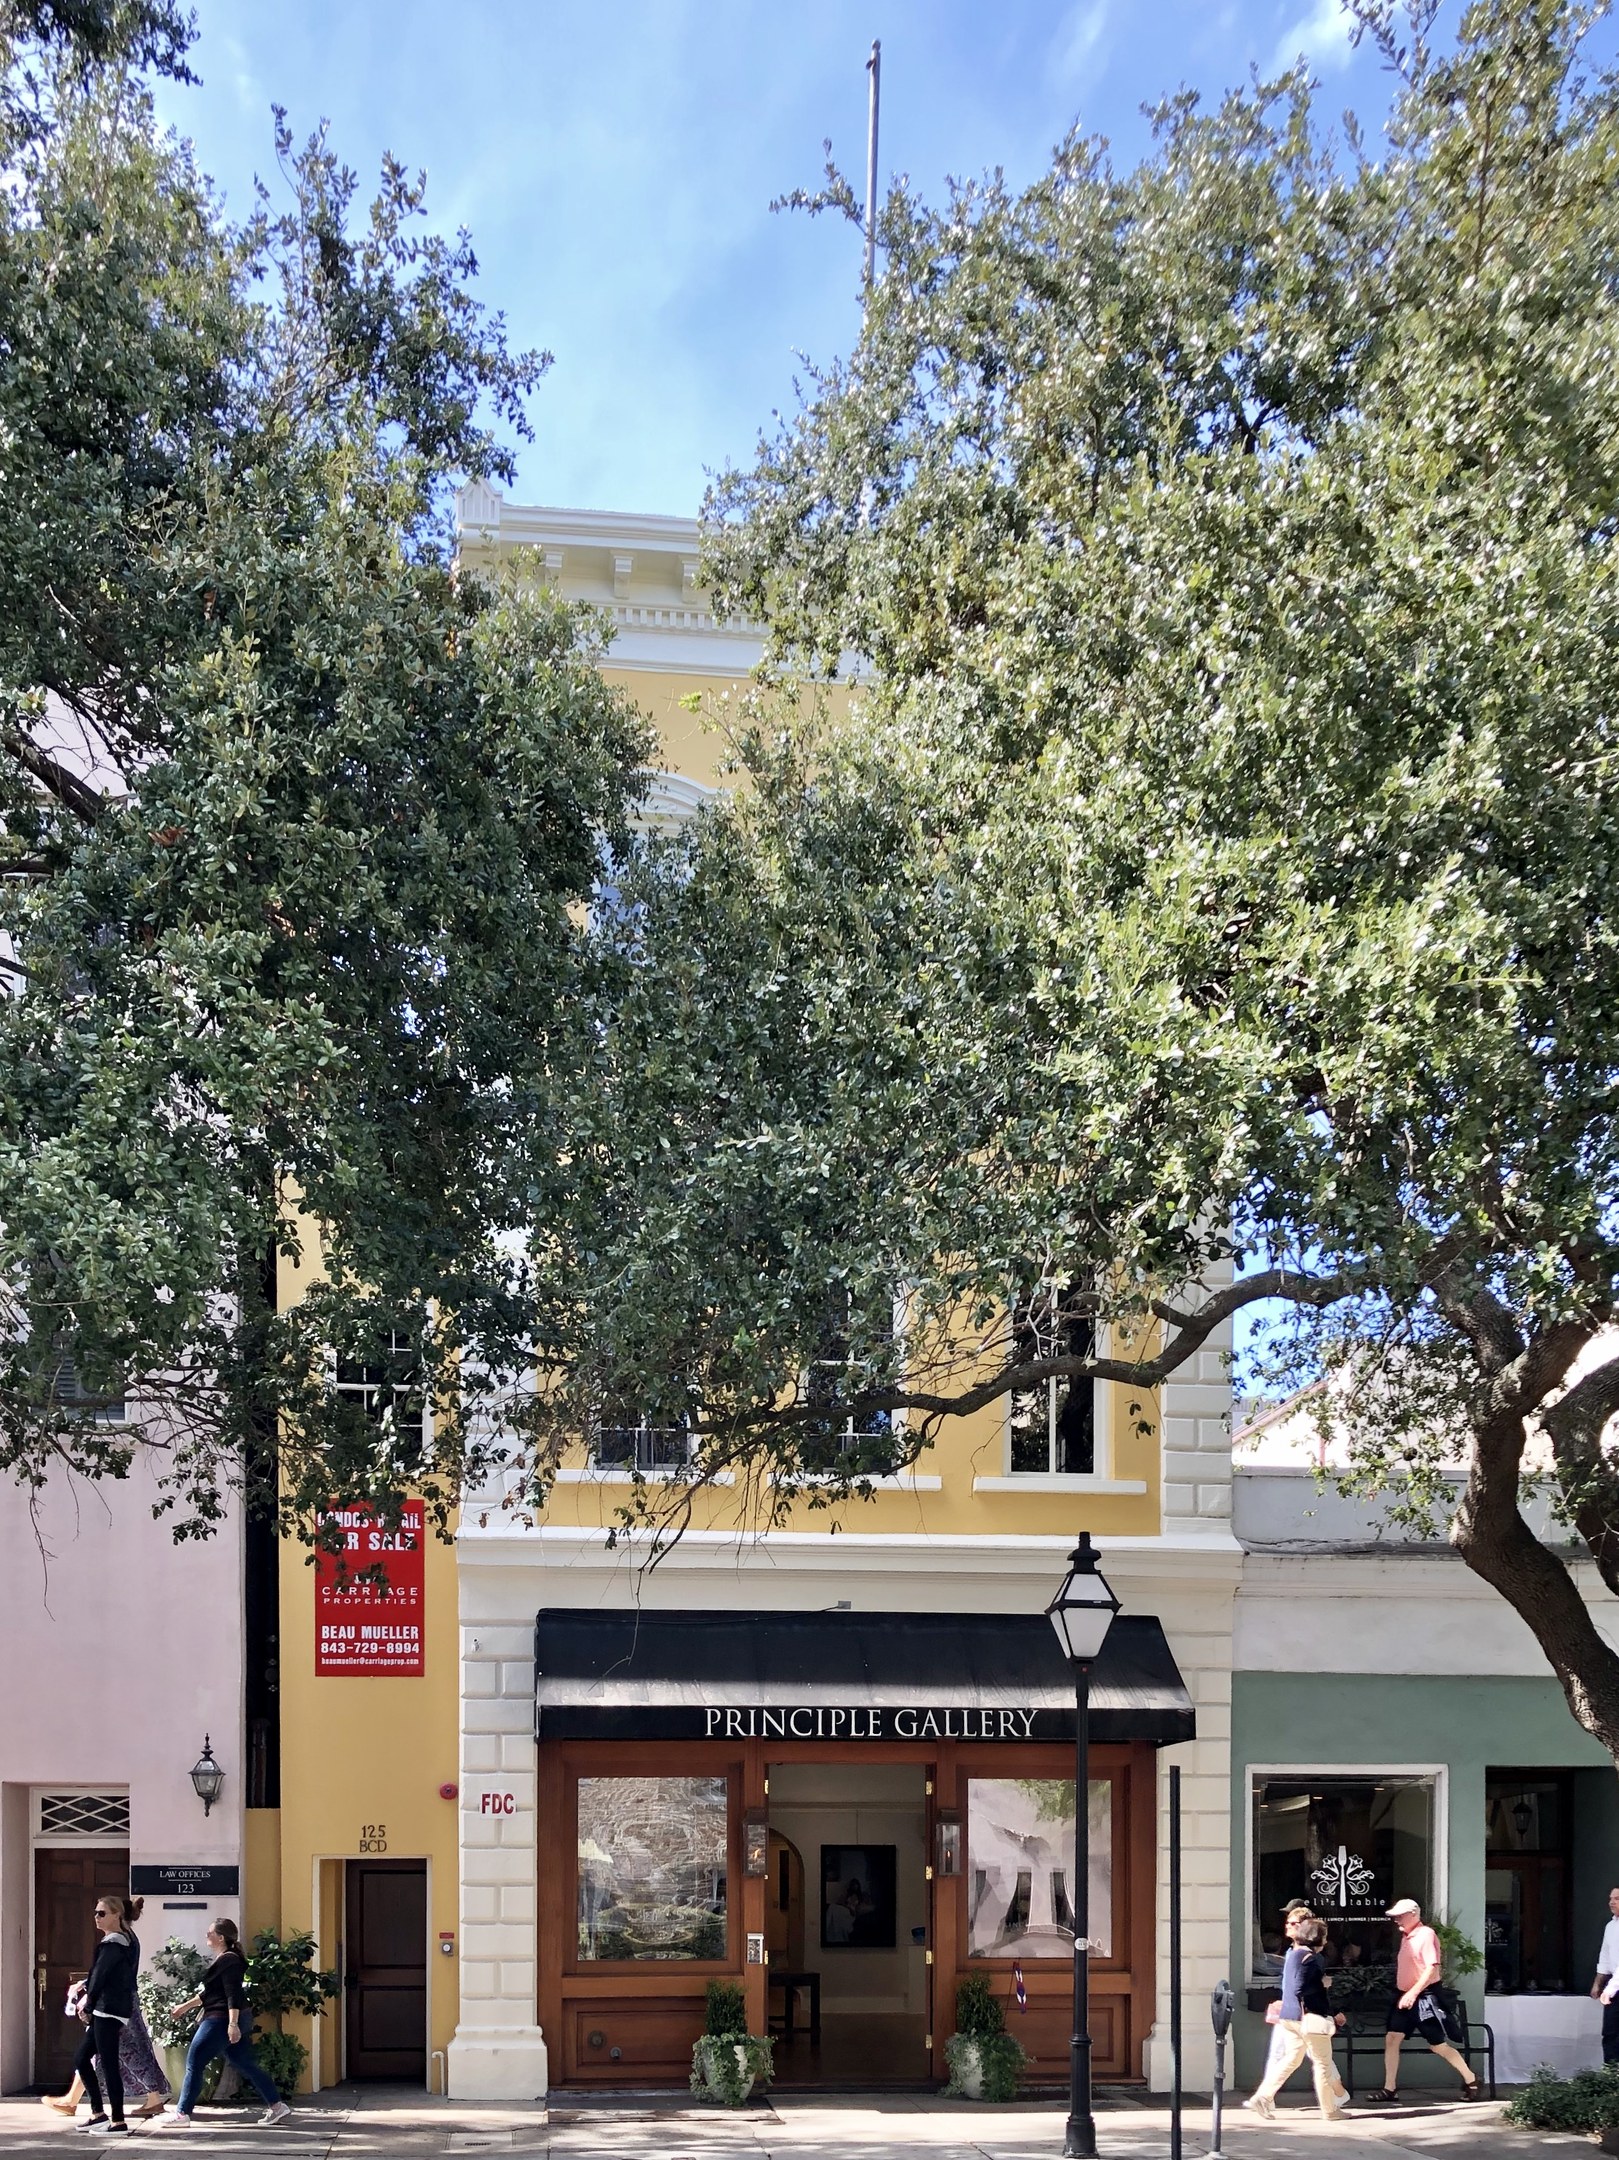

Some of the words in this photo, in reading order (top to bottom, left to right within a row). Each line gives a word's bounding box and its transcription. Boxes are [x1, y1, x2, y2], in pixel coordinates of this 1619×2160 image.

[321, 1625, 356, 1639] BEAU
[361, 1625, 419, 1640] MUELLER
[320, 1642, 420, 1654] 843-729-8994
[704, 1707, 883, 1737] PRINCIPLE
[894, 1709, 1039, 1738] GALLERY
[481, 1793, 514, 1815] FDC
[361, 1825, 386, 1838] 125
[359, 1839, 387, 1853] BCD
[159, 1870, 177, 1878] LAW
[178, 1870, 211, 1878] OFFICES
[177, 1883, 195, 1893] 123
[1303, 1898, 1335, 1906] eli's
[1350, 1898, 1386, 1906] table
